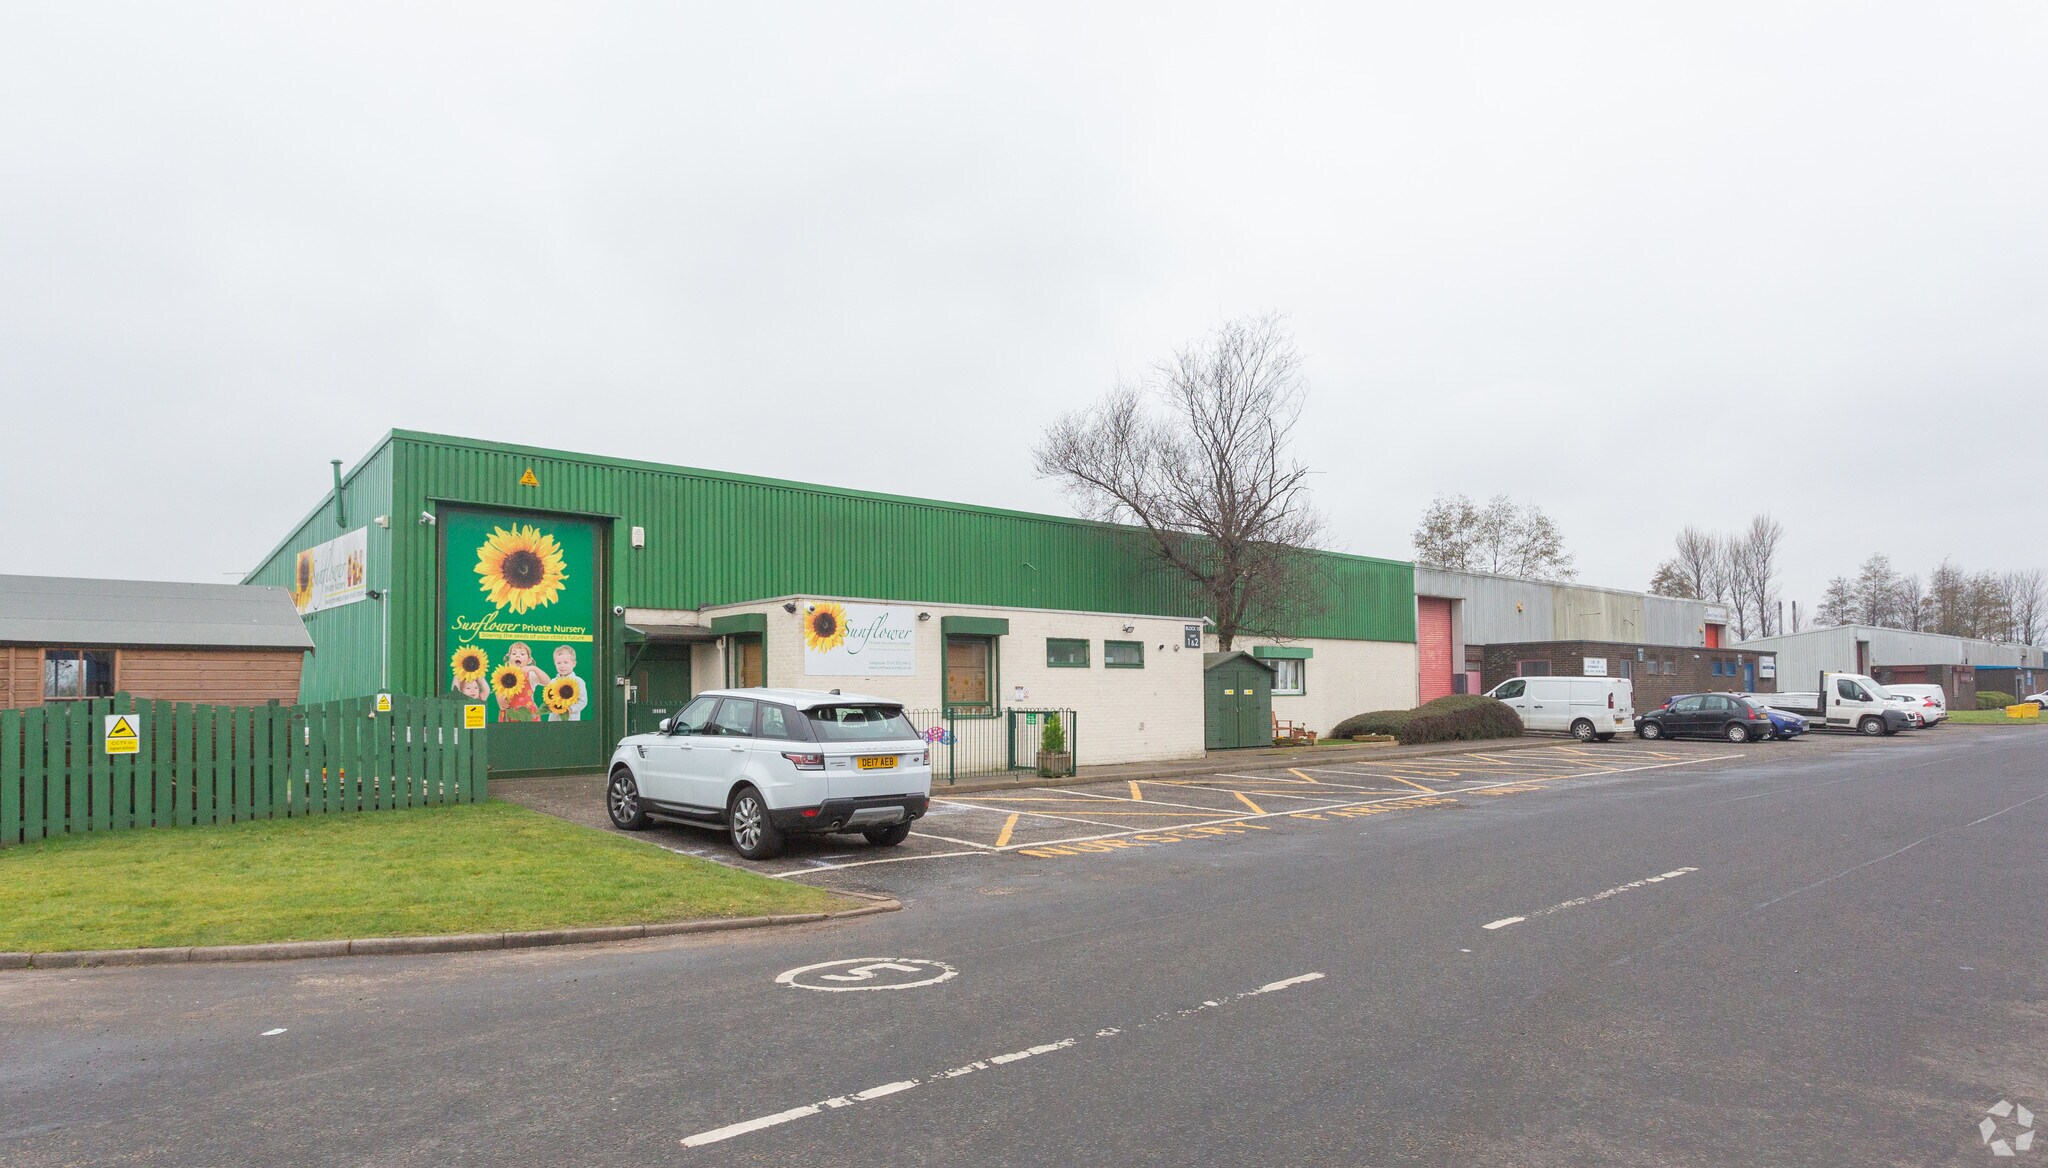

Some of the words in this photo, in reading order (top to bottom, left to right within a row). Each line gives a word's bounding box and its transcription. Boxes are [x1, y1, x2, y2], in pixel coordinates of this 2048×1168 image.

[451, 611, 521, 642] Sunflower
[554, 625, 586, 634] Nursery
[840, 613, 912, 654] Sunflower
[862, 757, 879, 767] DE17
[1018, 821, 1271, 858] NURSERY
